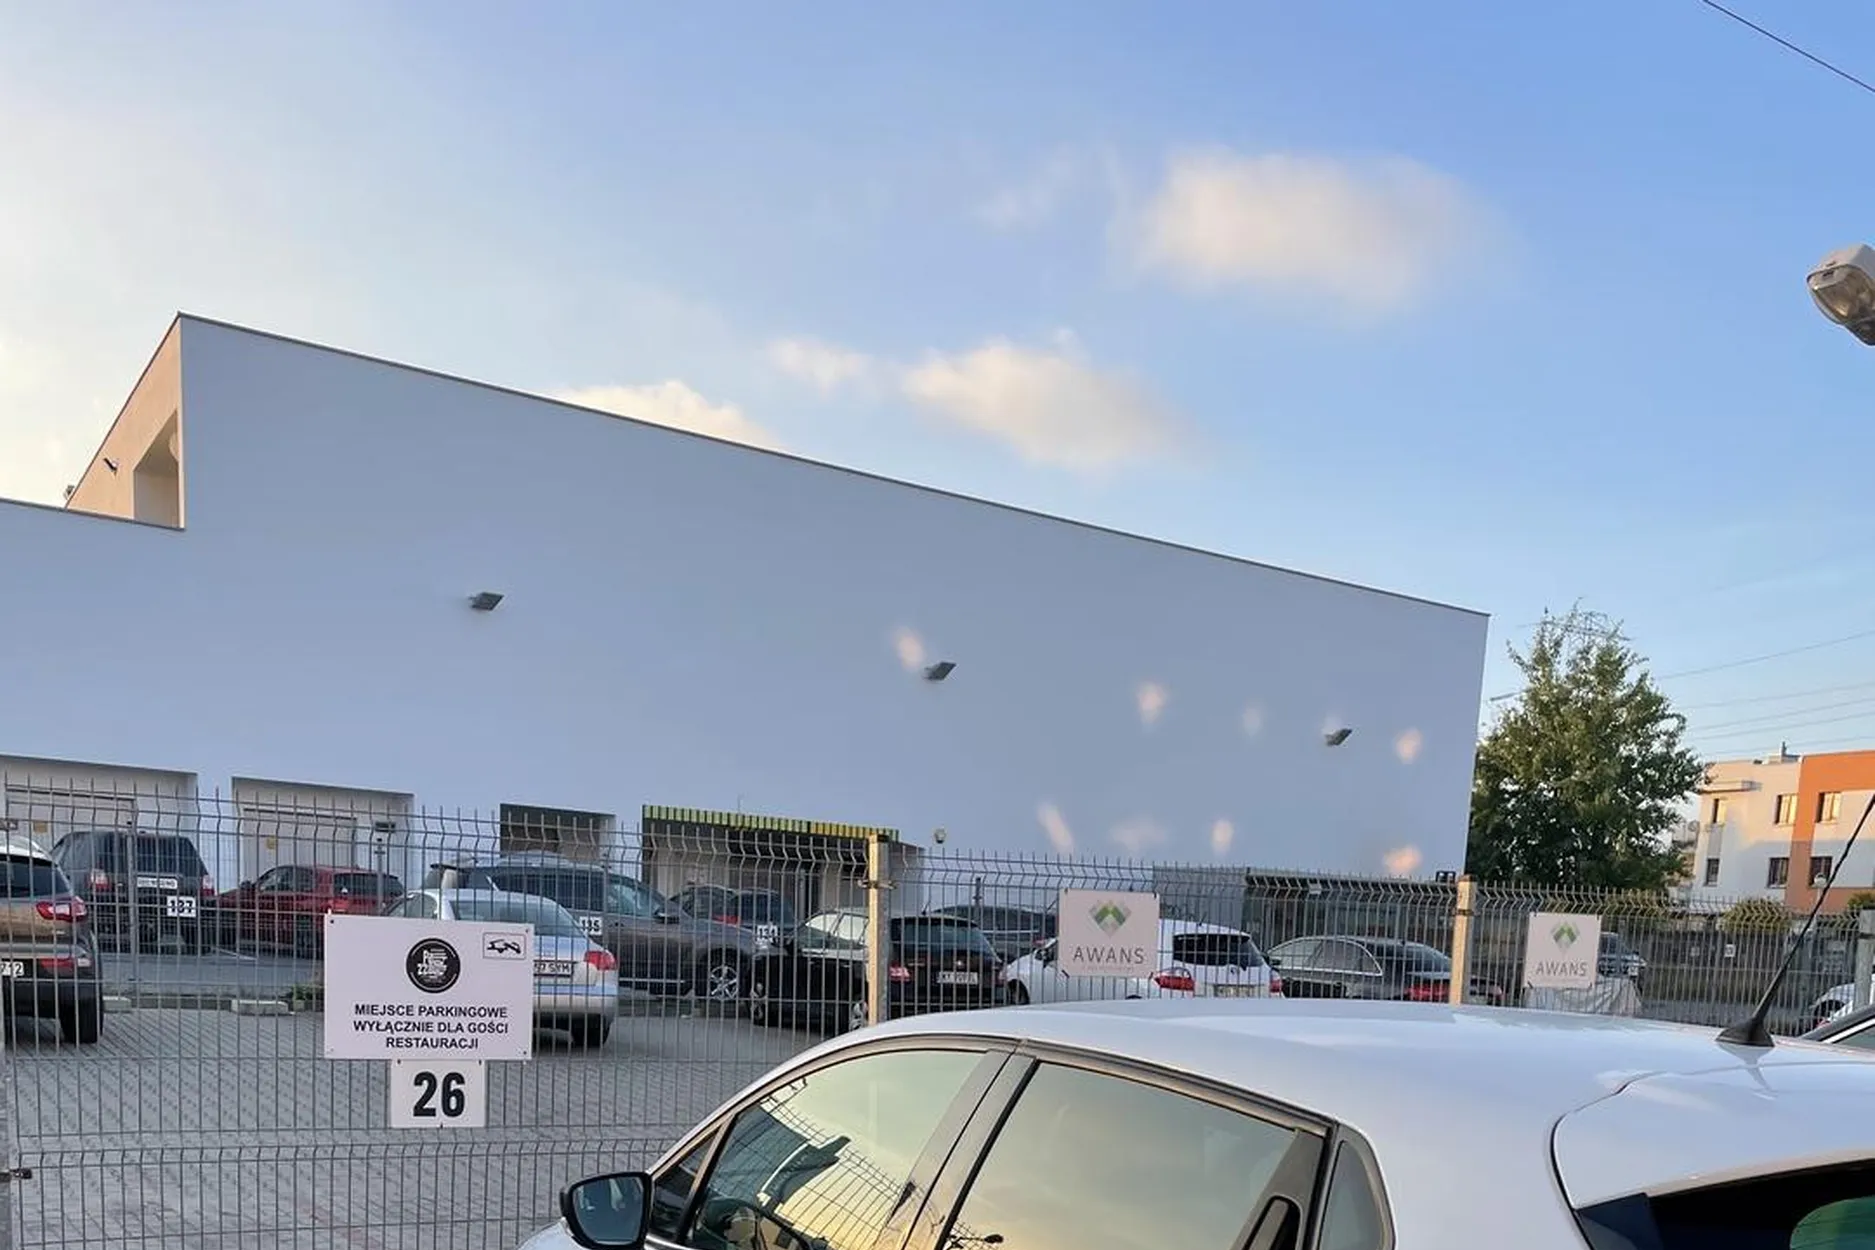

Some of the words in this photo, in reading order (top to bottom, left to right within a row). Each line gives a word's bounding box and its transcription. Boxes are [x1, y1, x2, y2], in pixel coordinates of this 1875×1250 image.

[1073, 946, 1145, 964] AWANS
[1536, 961, 1587, 977] AWANS
[355, 1004, 415, 1017] MIEJSCE
[418, 1005, 508, 1018] PARKINGOWE
[353, 1020, 434, 1035] WYŁĄCZNIE
[437, 1022, 464, 1033] DLA
[467, 1020, 508, 1034] GOŚCI
[386, 1037, 479, 1050] RESTAURACJI
[413, 1071, 466, 1118] 26
